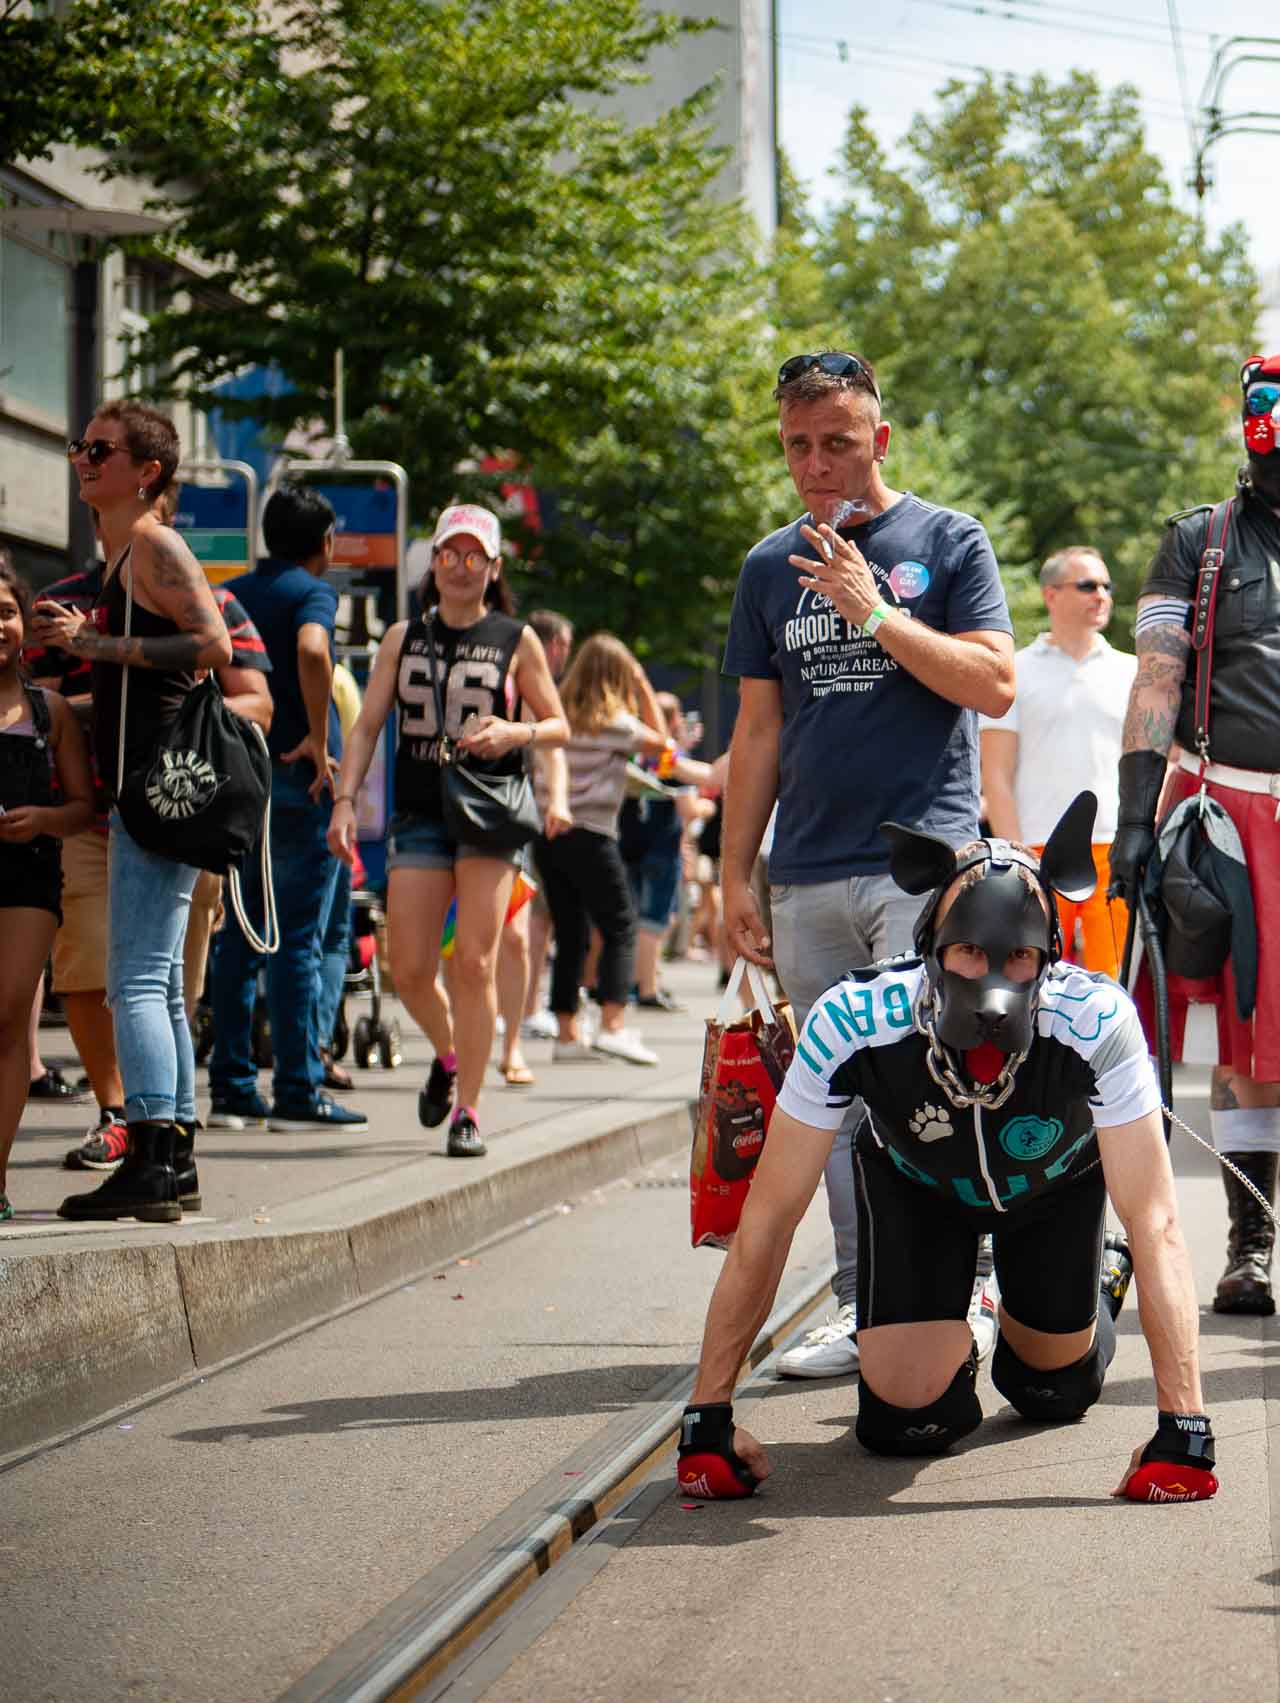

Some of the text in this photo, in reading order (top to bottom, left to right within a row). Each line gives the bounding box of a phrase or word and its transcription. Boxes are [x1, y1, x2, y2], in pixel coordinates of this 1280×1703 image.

[785, 613, 841, 652] RHODE
[456, 642, 505, 662] PLAYER
[800, 658, 897, 681] NATURAL AREAS
[854, 681, 874, 692] DEPT
[399, 655, 500, 741] 56
[147, 785, 195, 819] HAWAII
[797, 982, 912, 1075] BENJI
